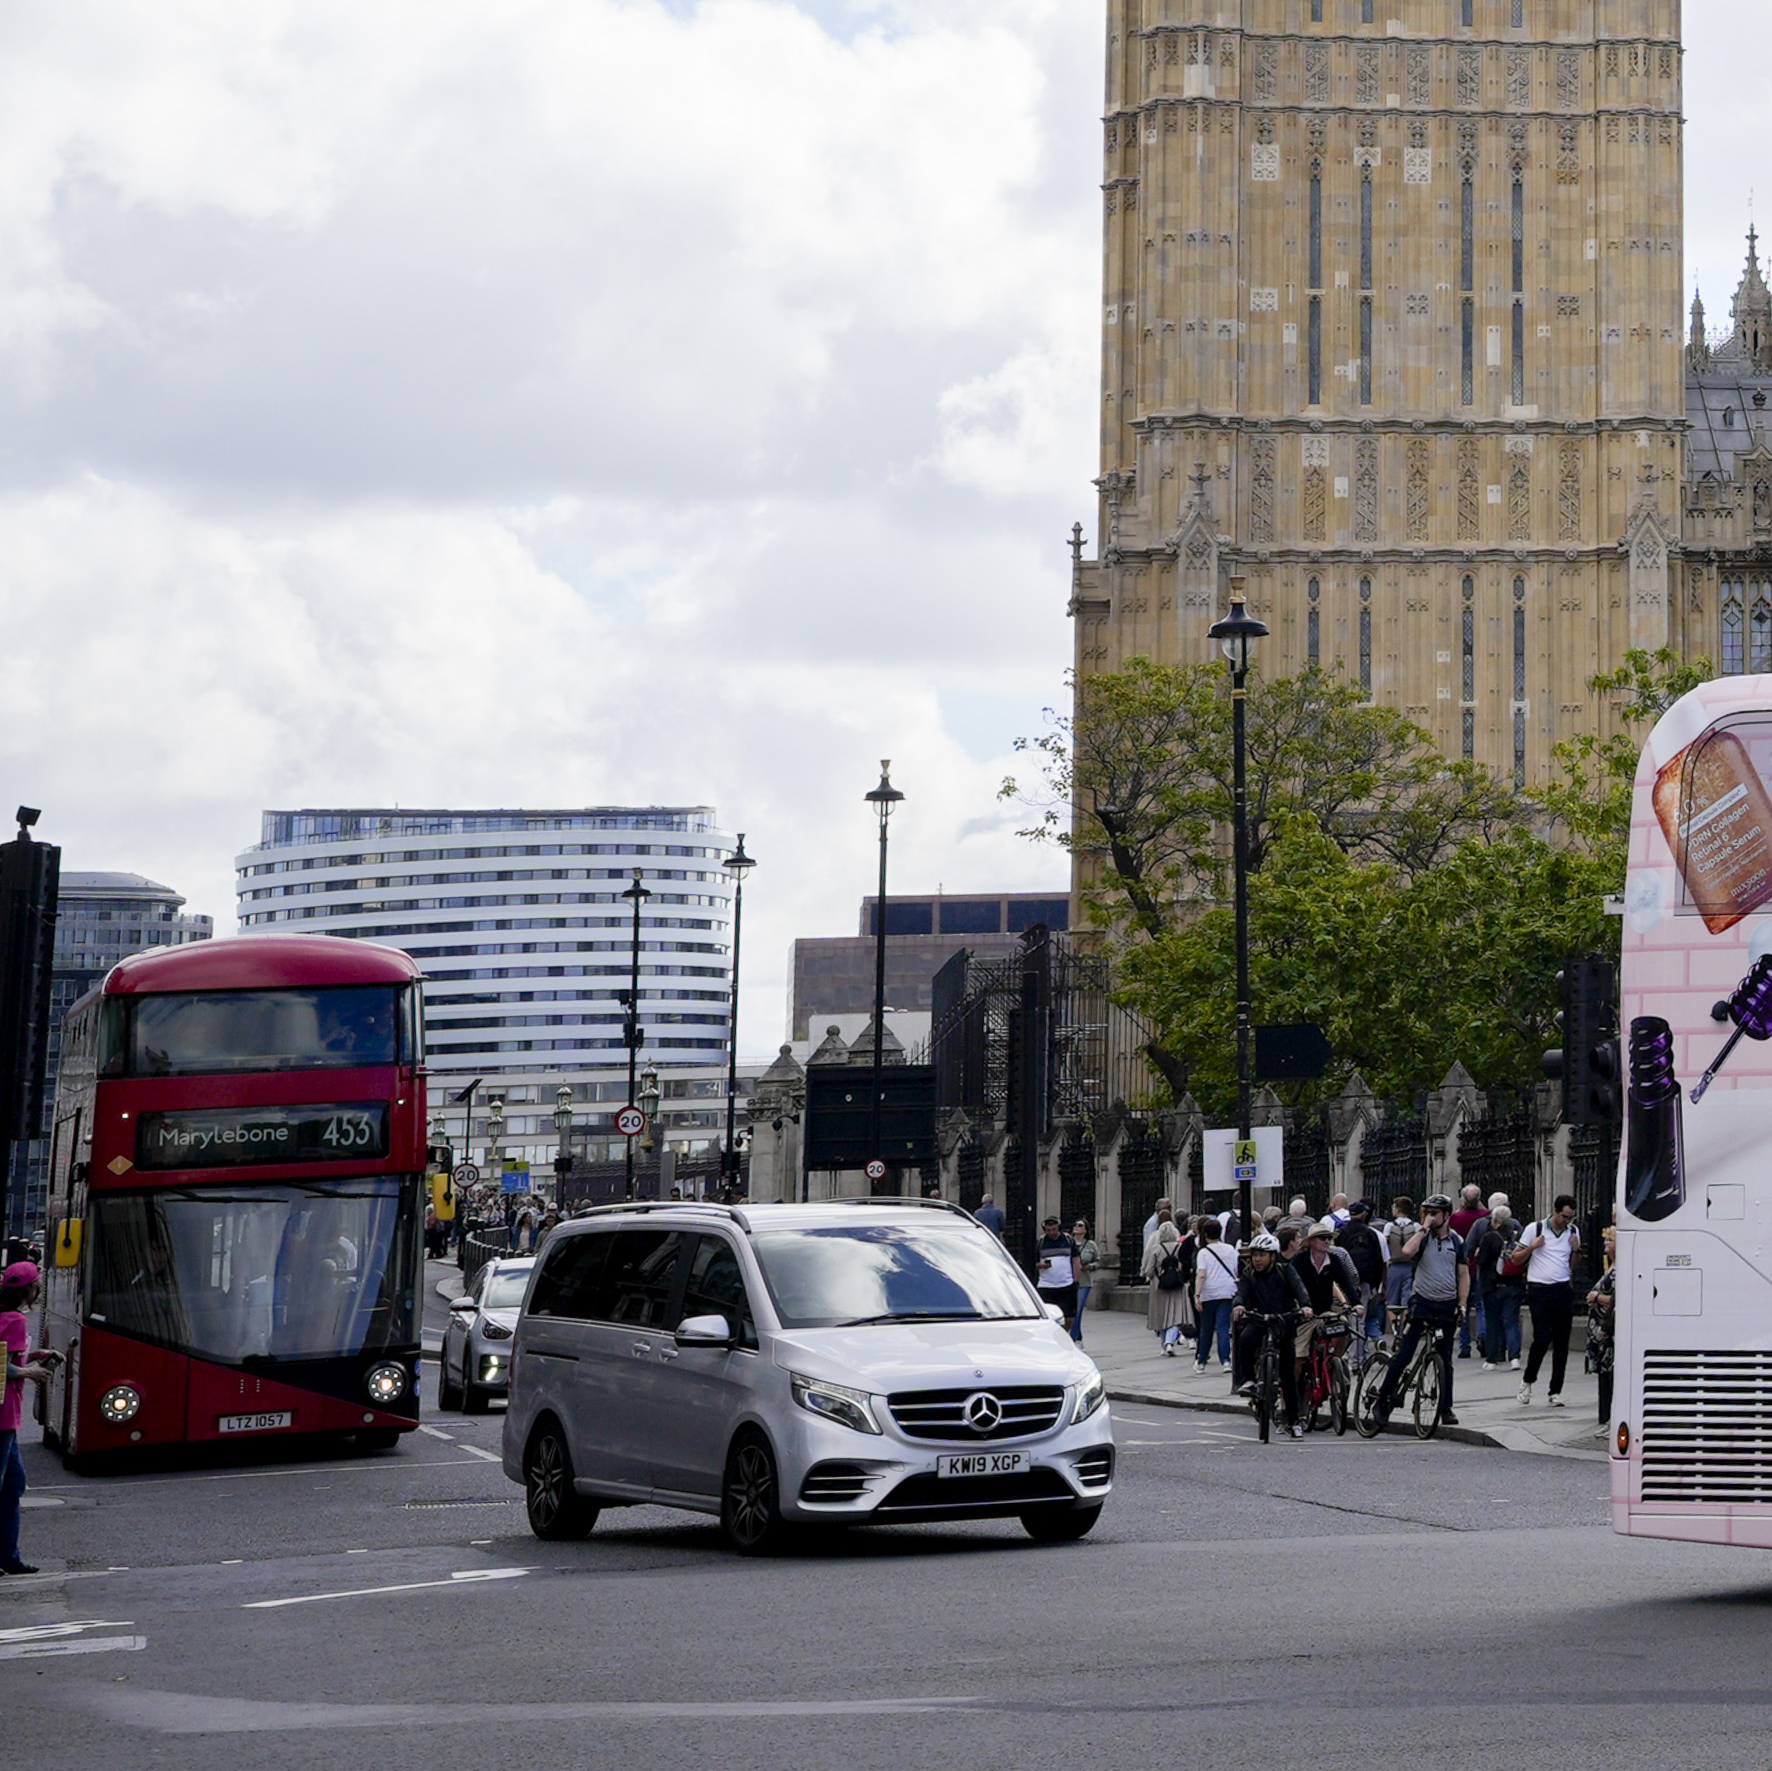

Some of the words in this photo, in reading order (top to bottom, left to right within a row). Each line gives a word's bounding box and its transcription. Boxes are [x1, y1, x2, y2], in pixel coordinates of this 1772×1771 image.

[1711, 802, 1750, 835] Collagen
[1691, 839, 1722, 863] Retinal
[1721, 832, 1730, 844] 6
[1697, 843, 1734, 874] Capsule
[1731, 824, 1762, 850] Serum
[322, 1112, 371, 1147] 453
[621, 1115, 642, 1128] 20
[158, 1125, 289, 1150] Marylebone
[457, 1170, 475, 1181] 20
[869, 1164, 884, 1174] 20
[227, 1417, 252, 1430] LTZ
[255, 1414, 284, 1428] 1057
[949, 1456, 987, 1475] KW19
[991, 1454, 1021, 1472] XGP
